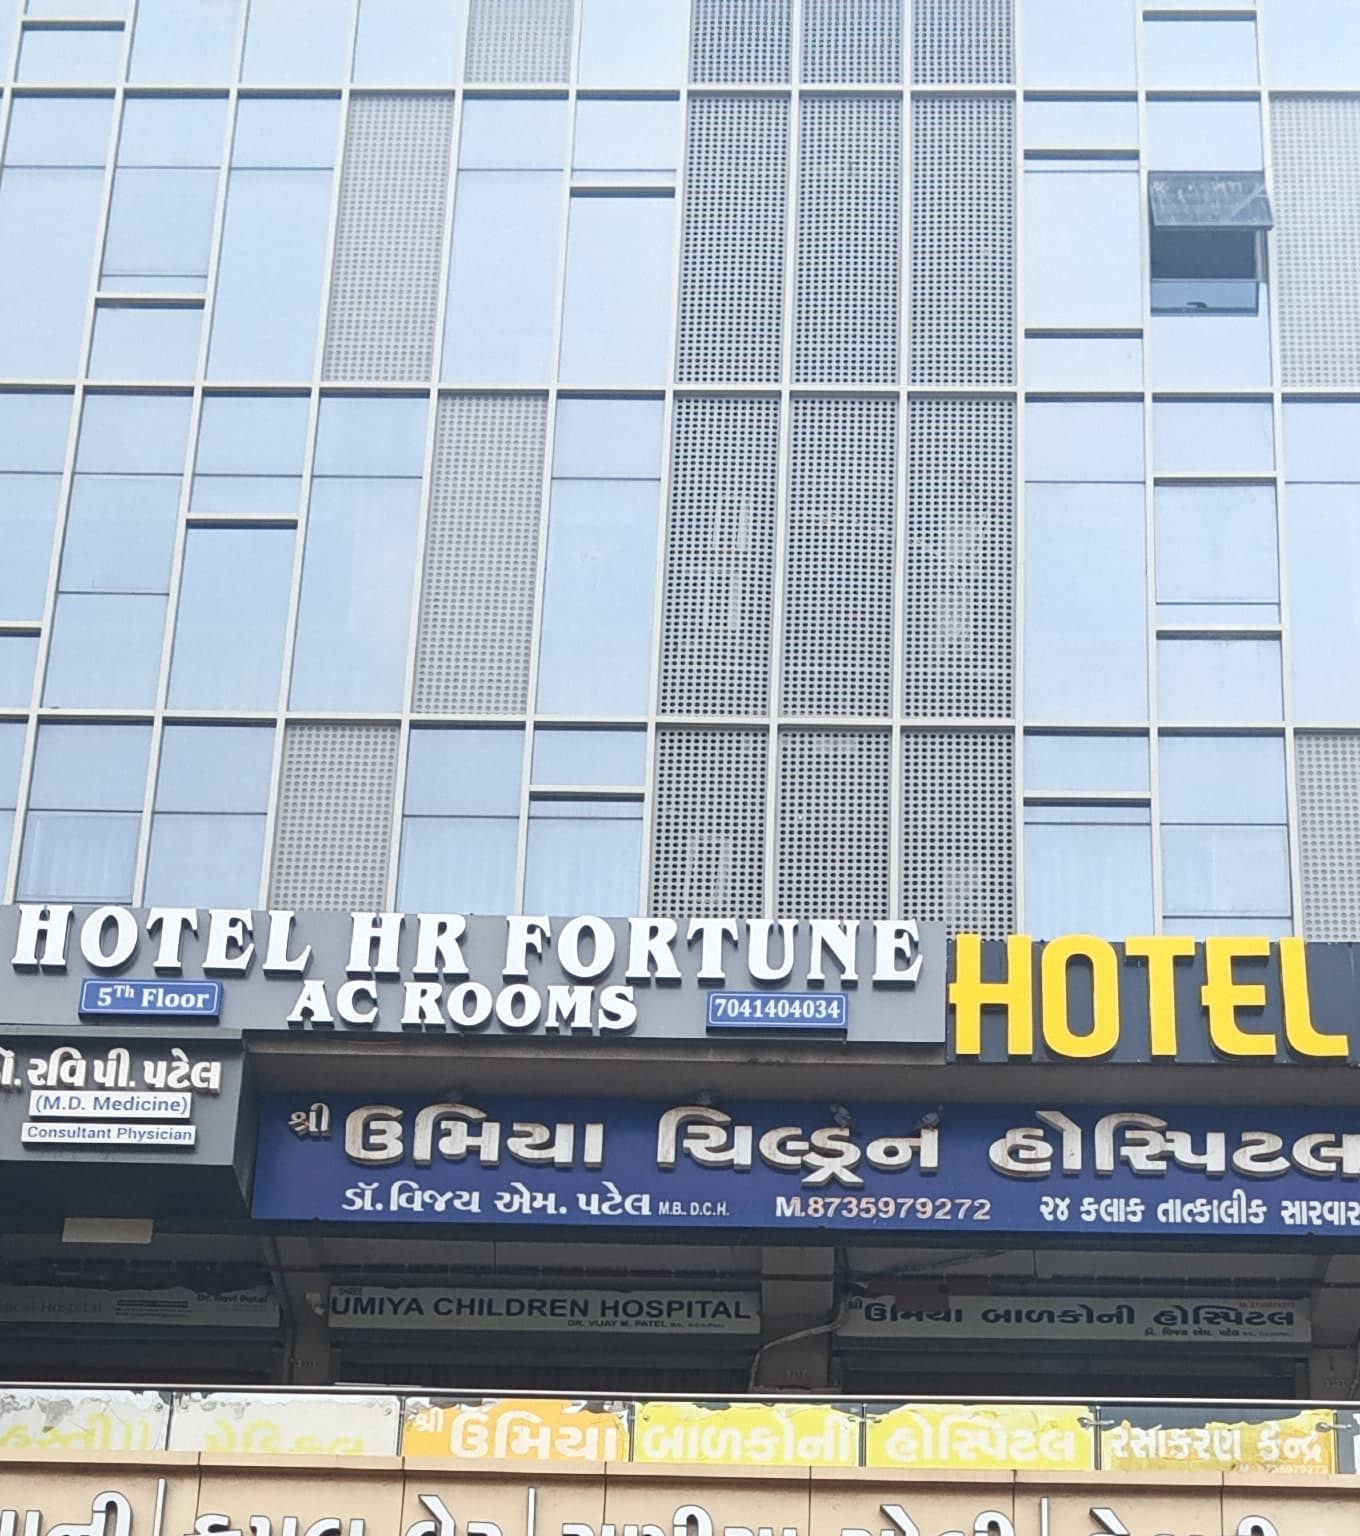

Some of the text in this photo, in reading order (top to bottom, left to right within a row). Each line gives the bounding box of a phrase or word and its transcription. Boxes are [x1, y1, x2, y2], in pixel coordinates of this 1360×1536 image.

[11, 905, 925, 984] HOTEL HR FORTUNE
[141, 980, 638, 1031] Floor AC ROOMS
[948, 932, 1349, 1058] HOTEL
[713, 998, 840, 1019] 7041404034
[36, 1094, 189, 1116] (M.D. Medicine)
[27, 1125, 193, 1142] Consultant Physician
[775, 1196, 991, 1221] M.8735979272
[331, 1297, 750, 1320] UMIYA CHILDREN HOSPITAL
